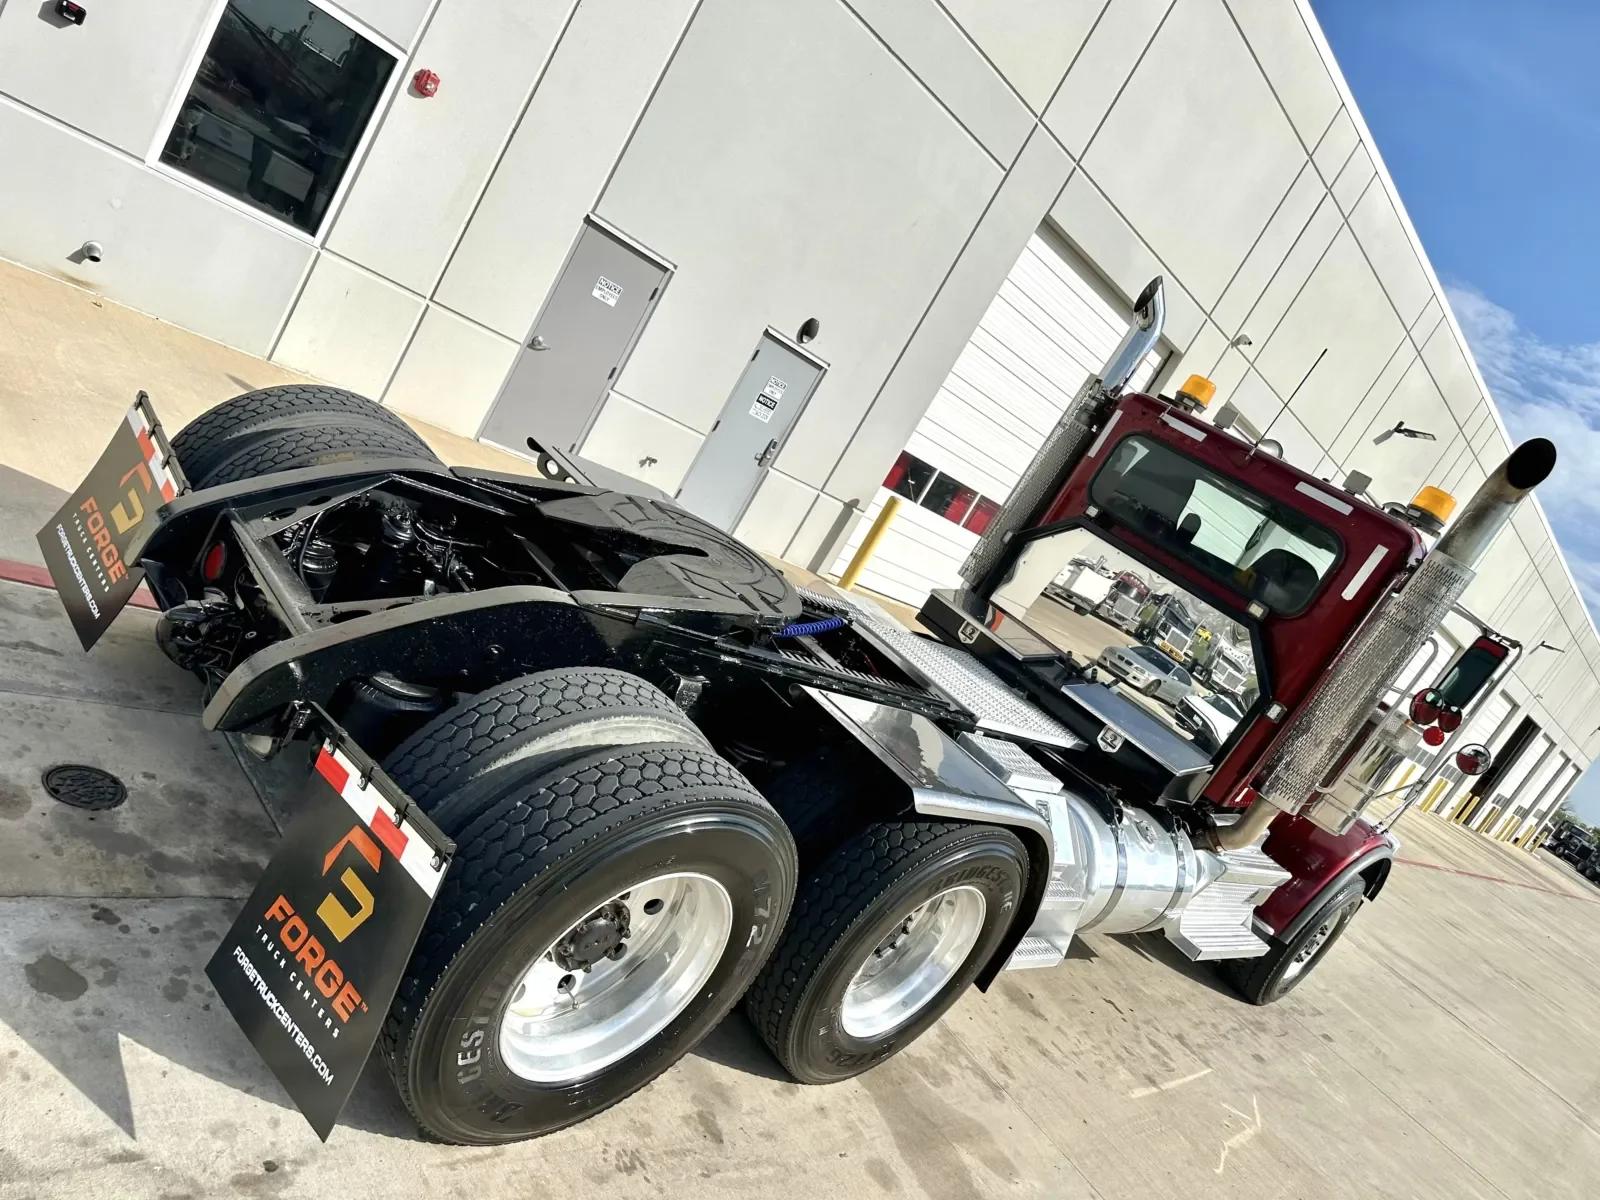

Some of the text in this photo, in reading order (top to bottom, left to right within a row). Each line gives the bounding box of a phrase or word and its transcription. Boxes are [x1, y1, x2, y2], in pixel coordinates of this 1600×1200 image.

[758, 395, 775, 408] NOTICE
[80, 496, 127, 584] FORGE
[255, 924, 286, 969] TRUCK
[264, 895, 362, 1023] FORGE
[233, 945, 334, 1086] FORGETRUCKCENTERS.COM
[289, 971, 340, 1039] CENTERS
